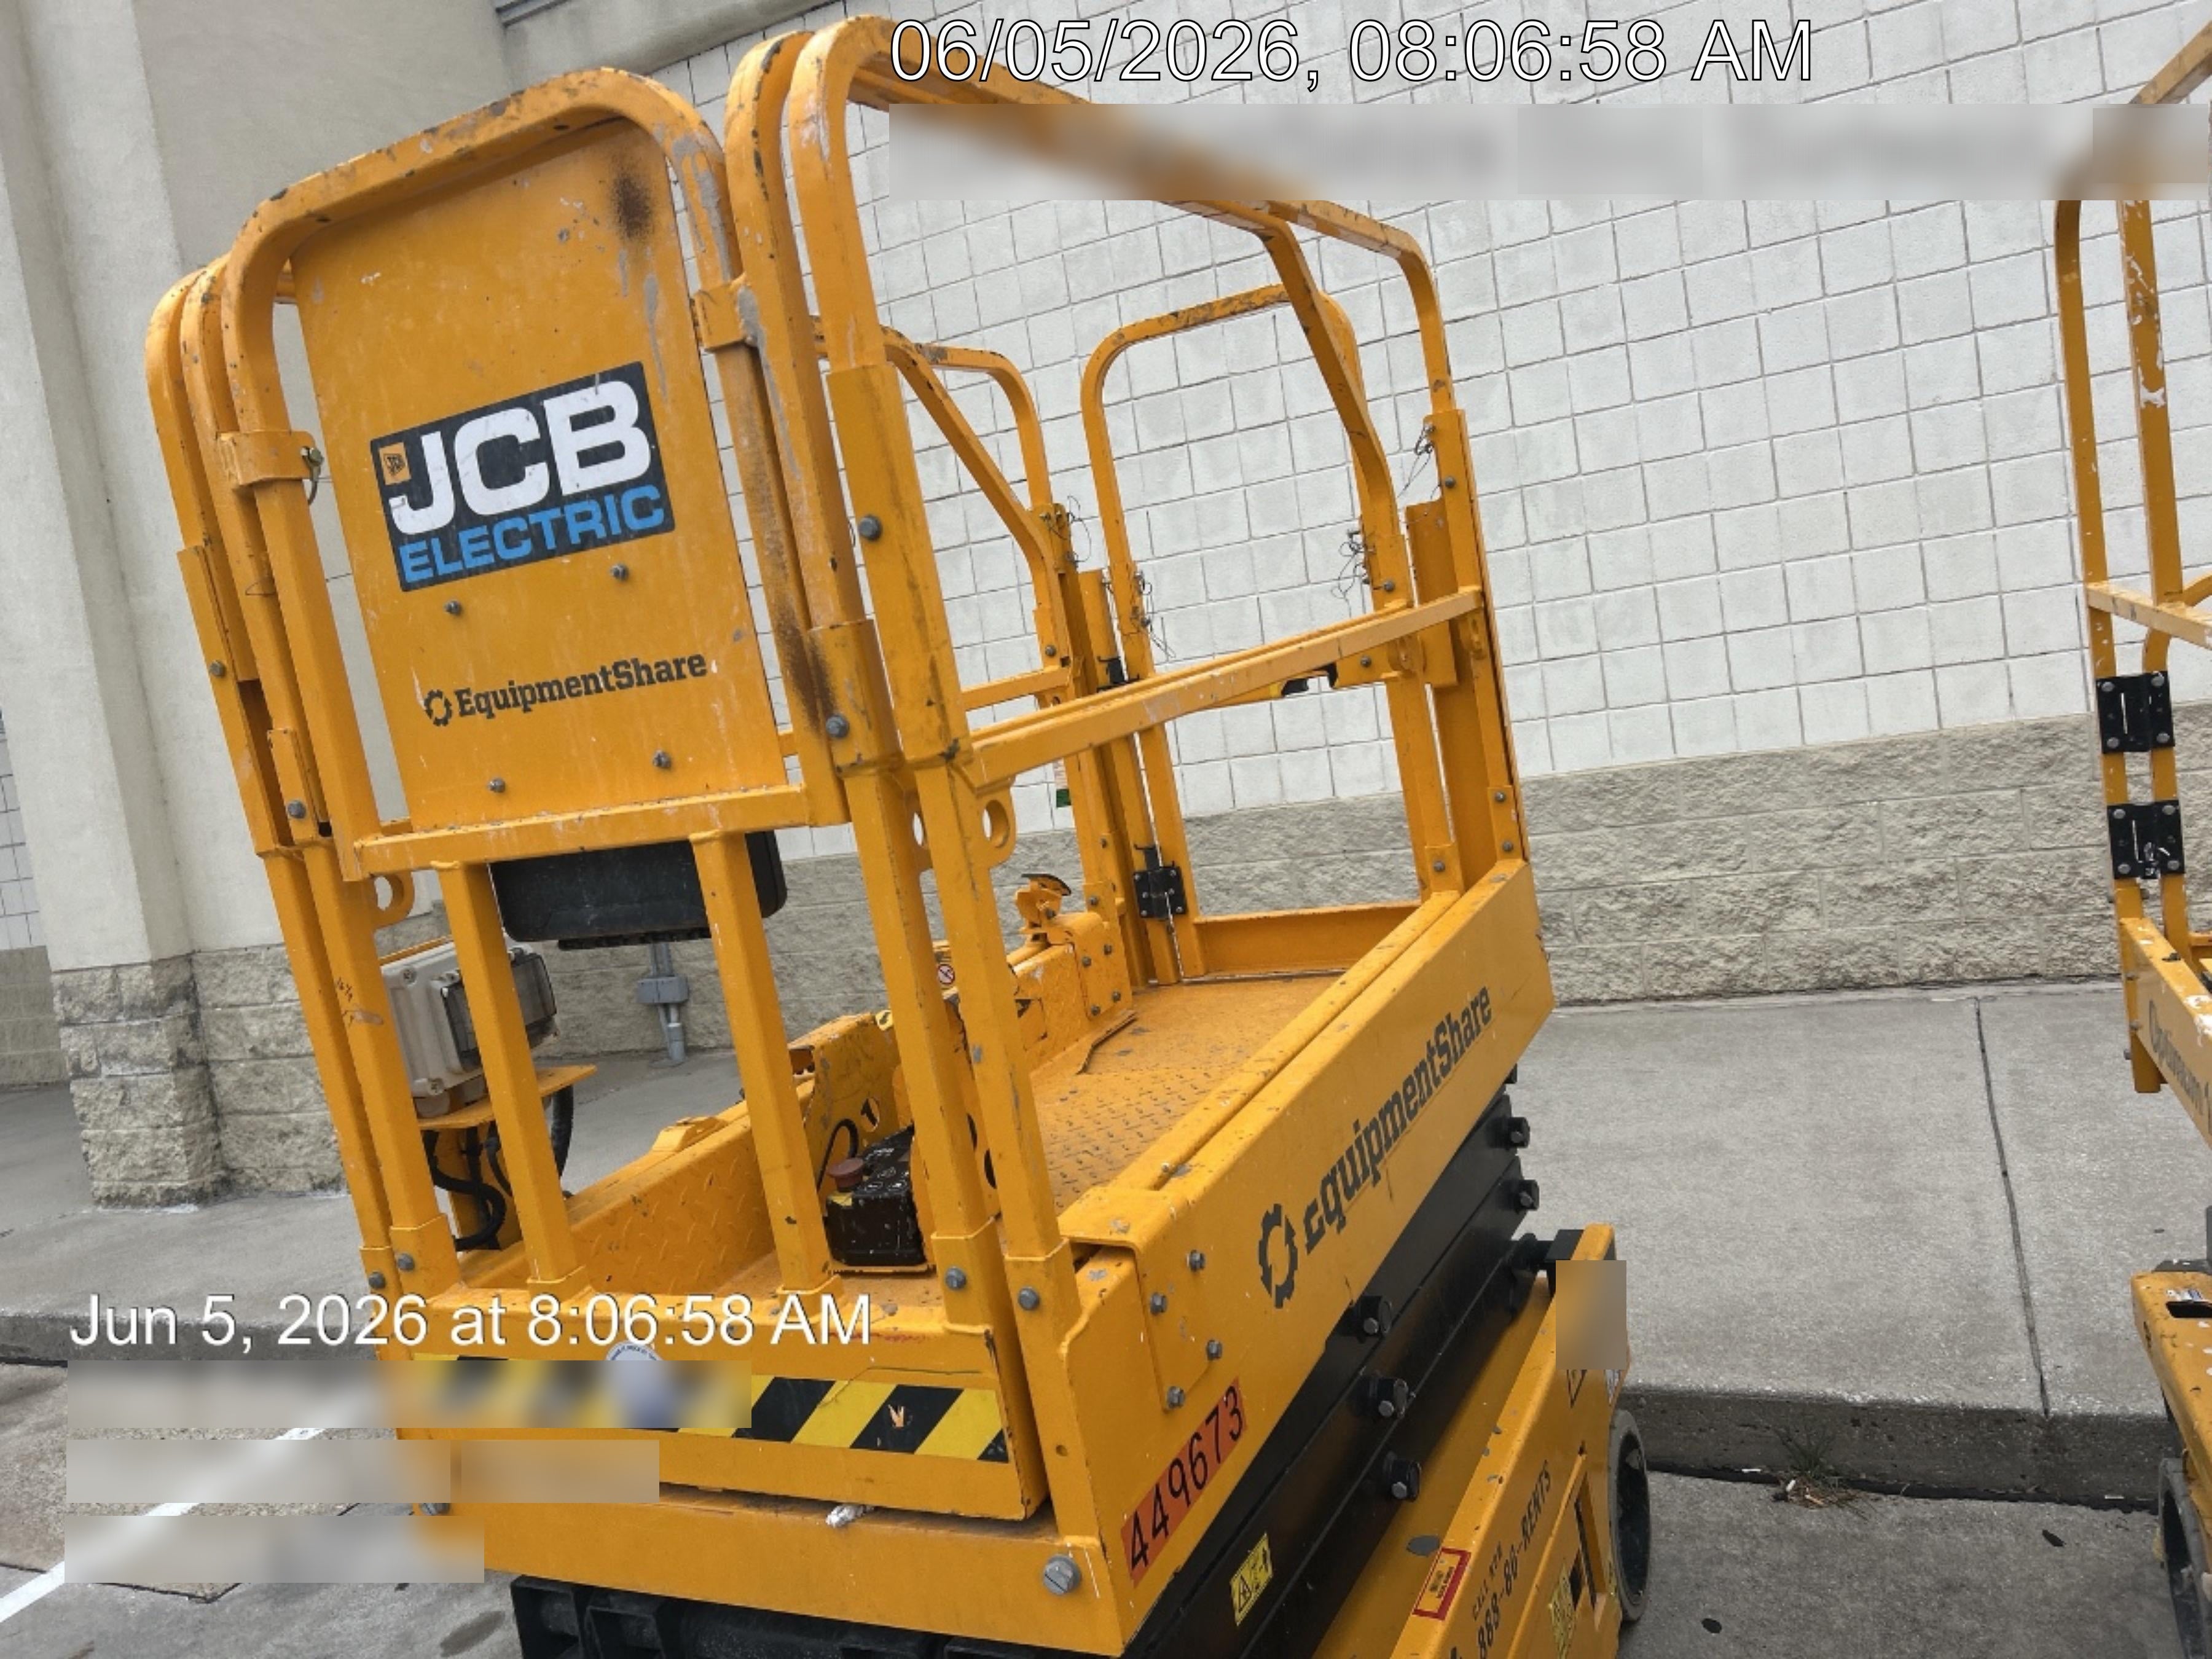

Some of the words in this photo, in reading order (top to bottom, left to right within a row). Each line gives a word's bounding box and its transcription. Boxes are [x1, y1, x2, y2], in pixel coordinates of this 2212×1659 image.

[388, 380, 651, 535] JCB
[399, 485, 665, 584] ELECTRIC
[455, 653, 708, 719] EquipmentShare
[1131, 1385, 1244, 1571] 449673
